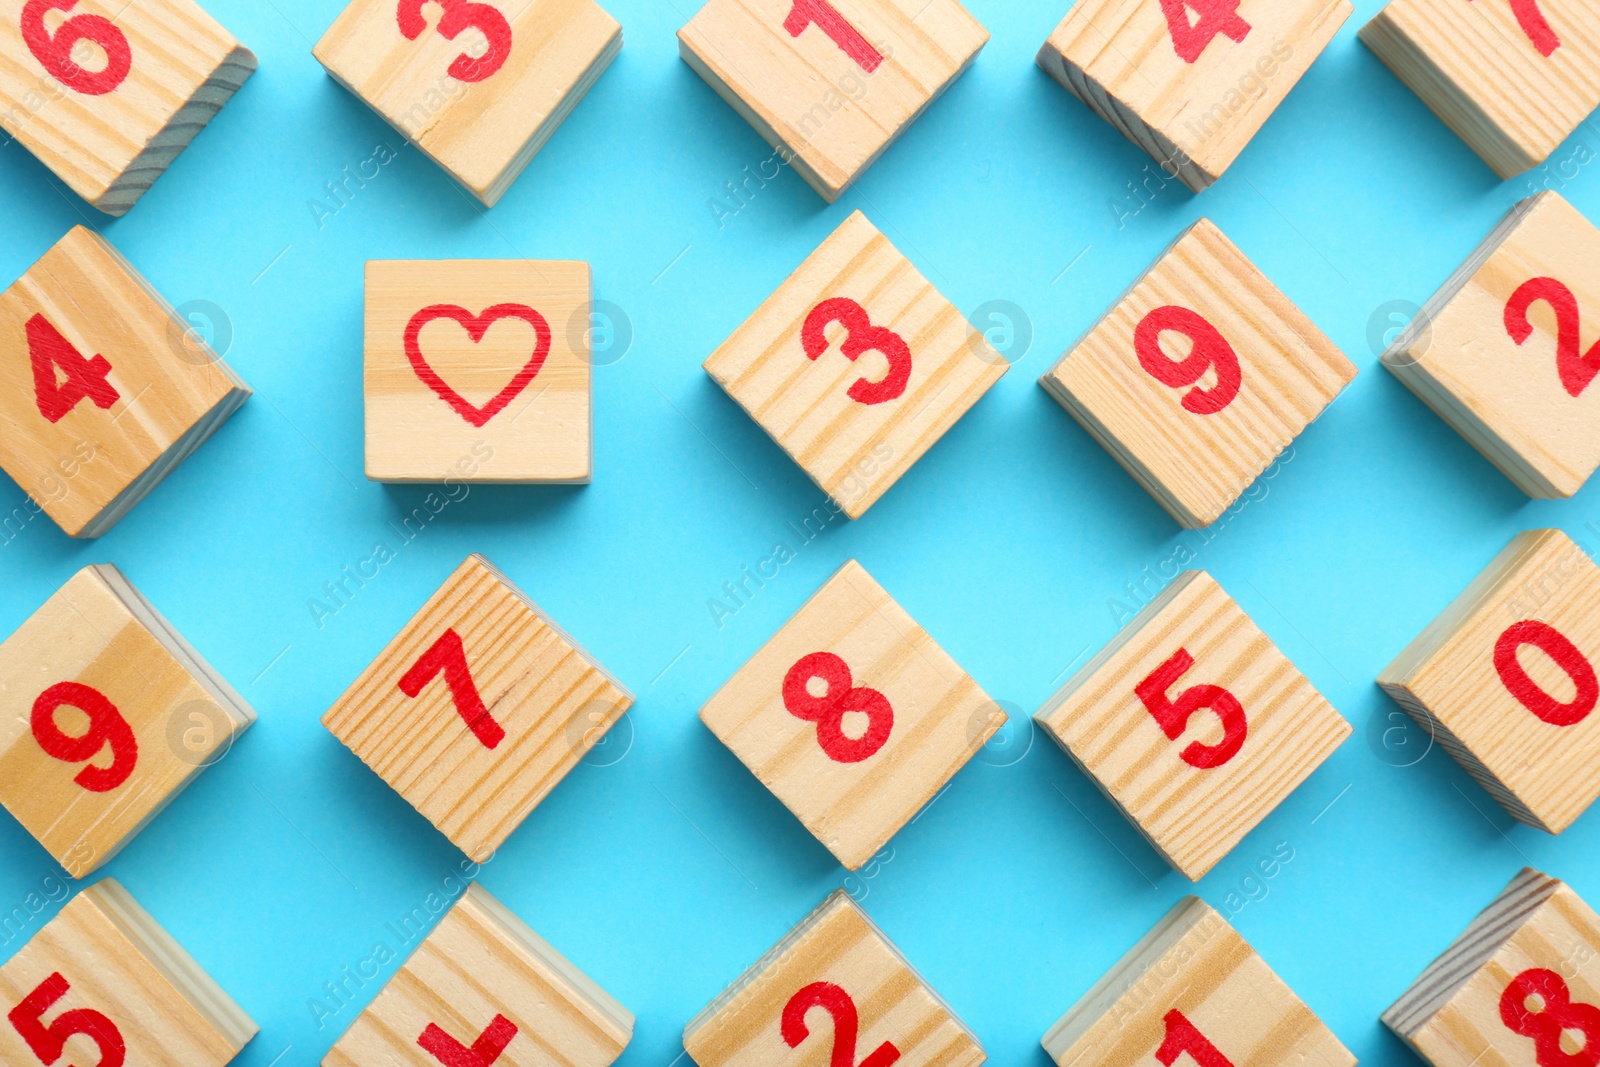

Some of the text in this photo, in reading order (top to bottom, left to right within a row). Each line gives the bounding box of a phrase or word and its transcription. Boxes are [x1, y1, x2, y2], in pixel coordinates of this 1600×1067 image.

[21, 0, 132, 96] 6
[397, 0, 512, 82] 3
[784, 0, 884, 73] 1
[1160, 0, 1252, 64] 4
[25, 313, 120, 424] 4
[801, 298, 912, 405] 3
[1133, 305, 1242, 415] 9
[1504, 277, 1600, 397] 2
[398, 628, 506, 751] 7
[782, 652, 894, 764] 8
[1134, 647, 1249, 769] 5
[1493, 620, 1600, 727] 0
[30, 681, 138, 793] 9
[8, 971, 126, 1067] 5
[781, 980, 901, 1067] 2
[1499, 968, 1600, 1067] 8
